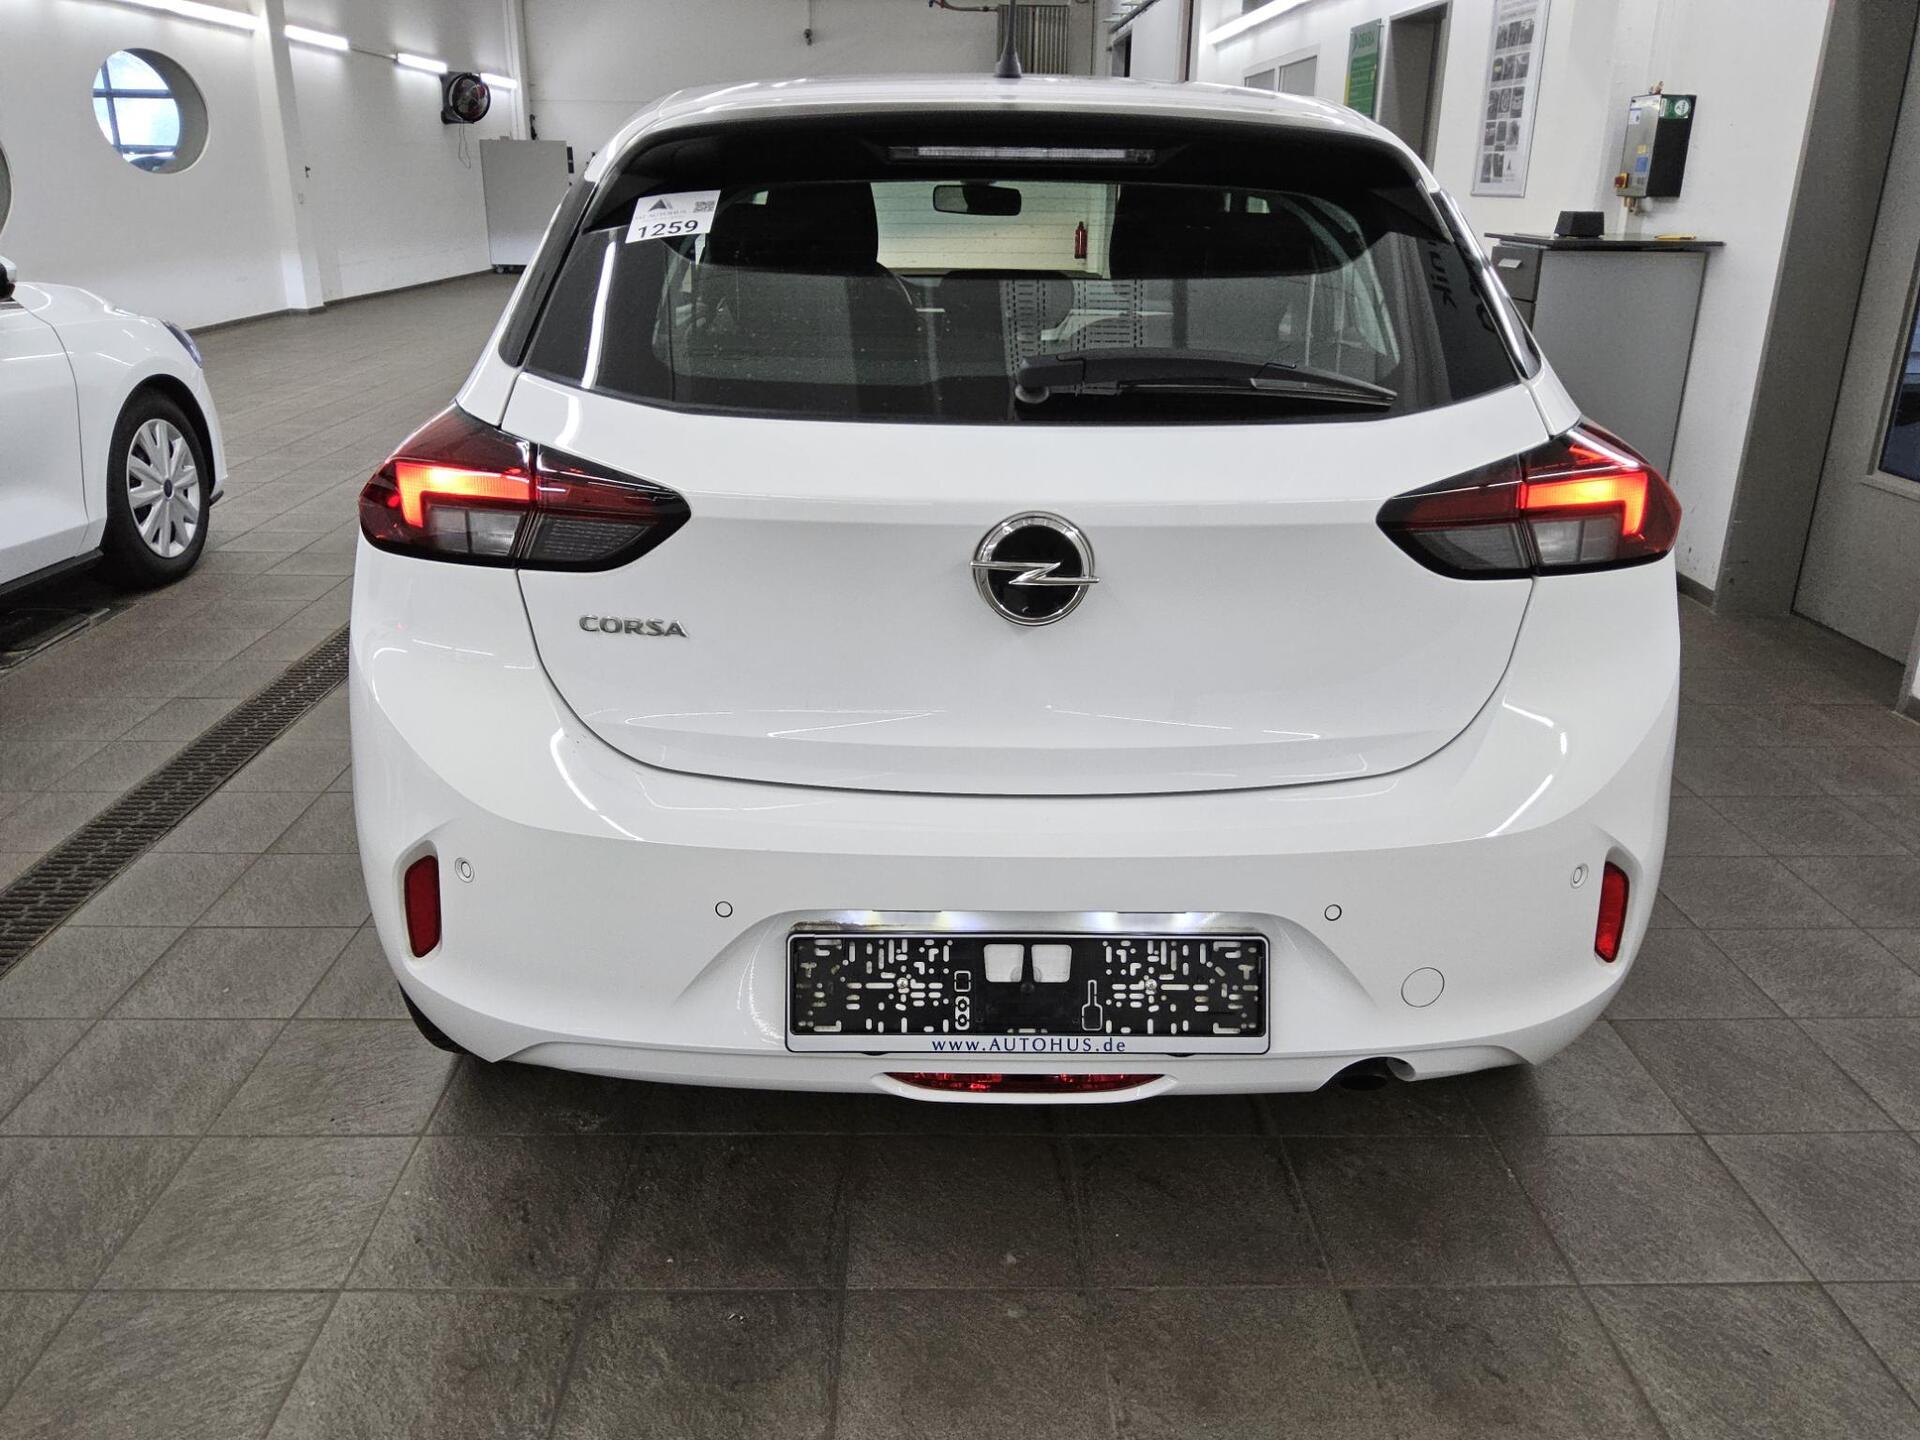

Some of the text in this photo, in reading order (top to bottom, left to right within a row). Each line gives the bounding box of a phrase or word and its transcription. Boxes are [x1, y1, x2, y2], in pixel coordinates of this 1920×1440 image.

[638, 219, 698, 238] 1259
[578, 614, 689, 638] CORSA
[931, 1037, 1127, 1052] www.AUTOHUS.de
